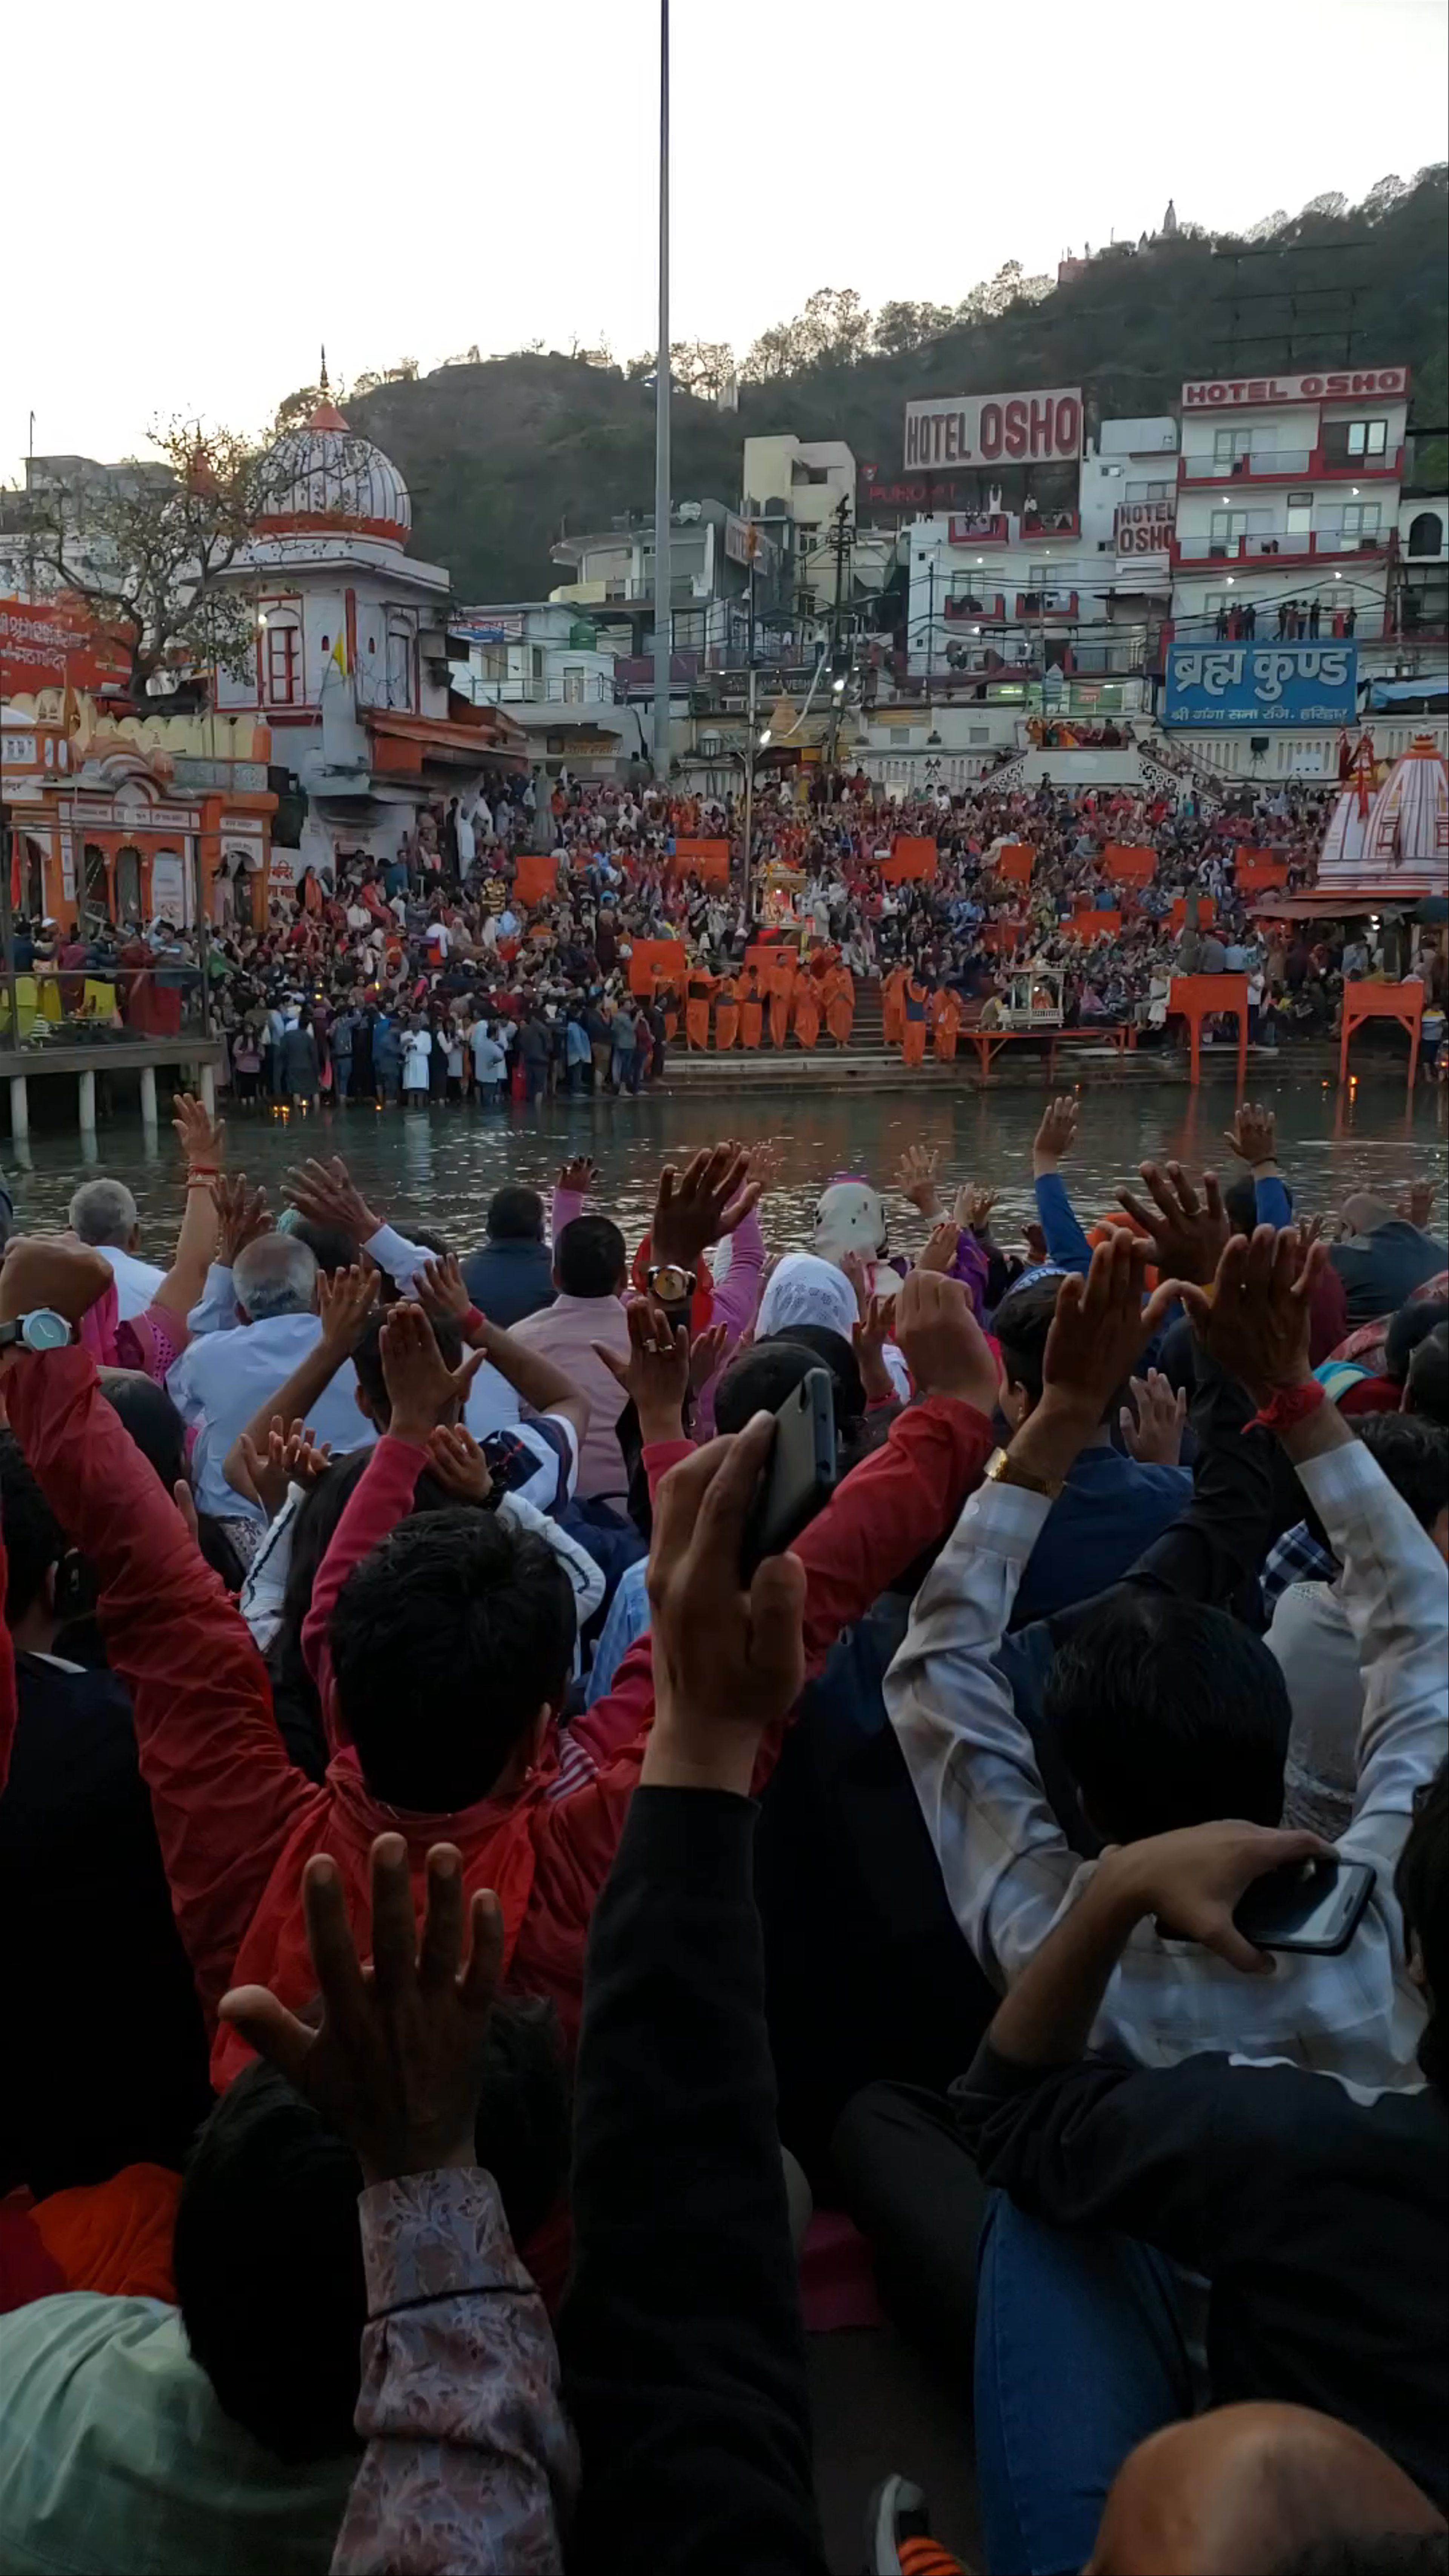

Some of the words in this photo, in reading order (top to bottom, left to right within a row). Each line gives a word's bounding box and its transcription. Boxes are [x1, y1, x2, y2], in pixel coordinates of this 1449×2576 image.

[1188, 380, 1287, 403] HOTEL
[1300, 372, 1400, 396] OSHO
[907, 412, 972, 465] HOTEL
[980, 396, 1078, 460] OSHO
[1120, 503, 1175, 526] HOTEL
[1120, 524, 1175, 552] OSHO
[1173, 649, 1246, 695] ब्रह्म
[1252, 647, 1352, 701] कुण्ड
[1171, 706, 1189, 721] श्री
